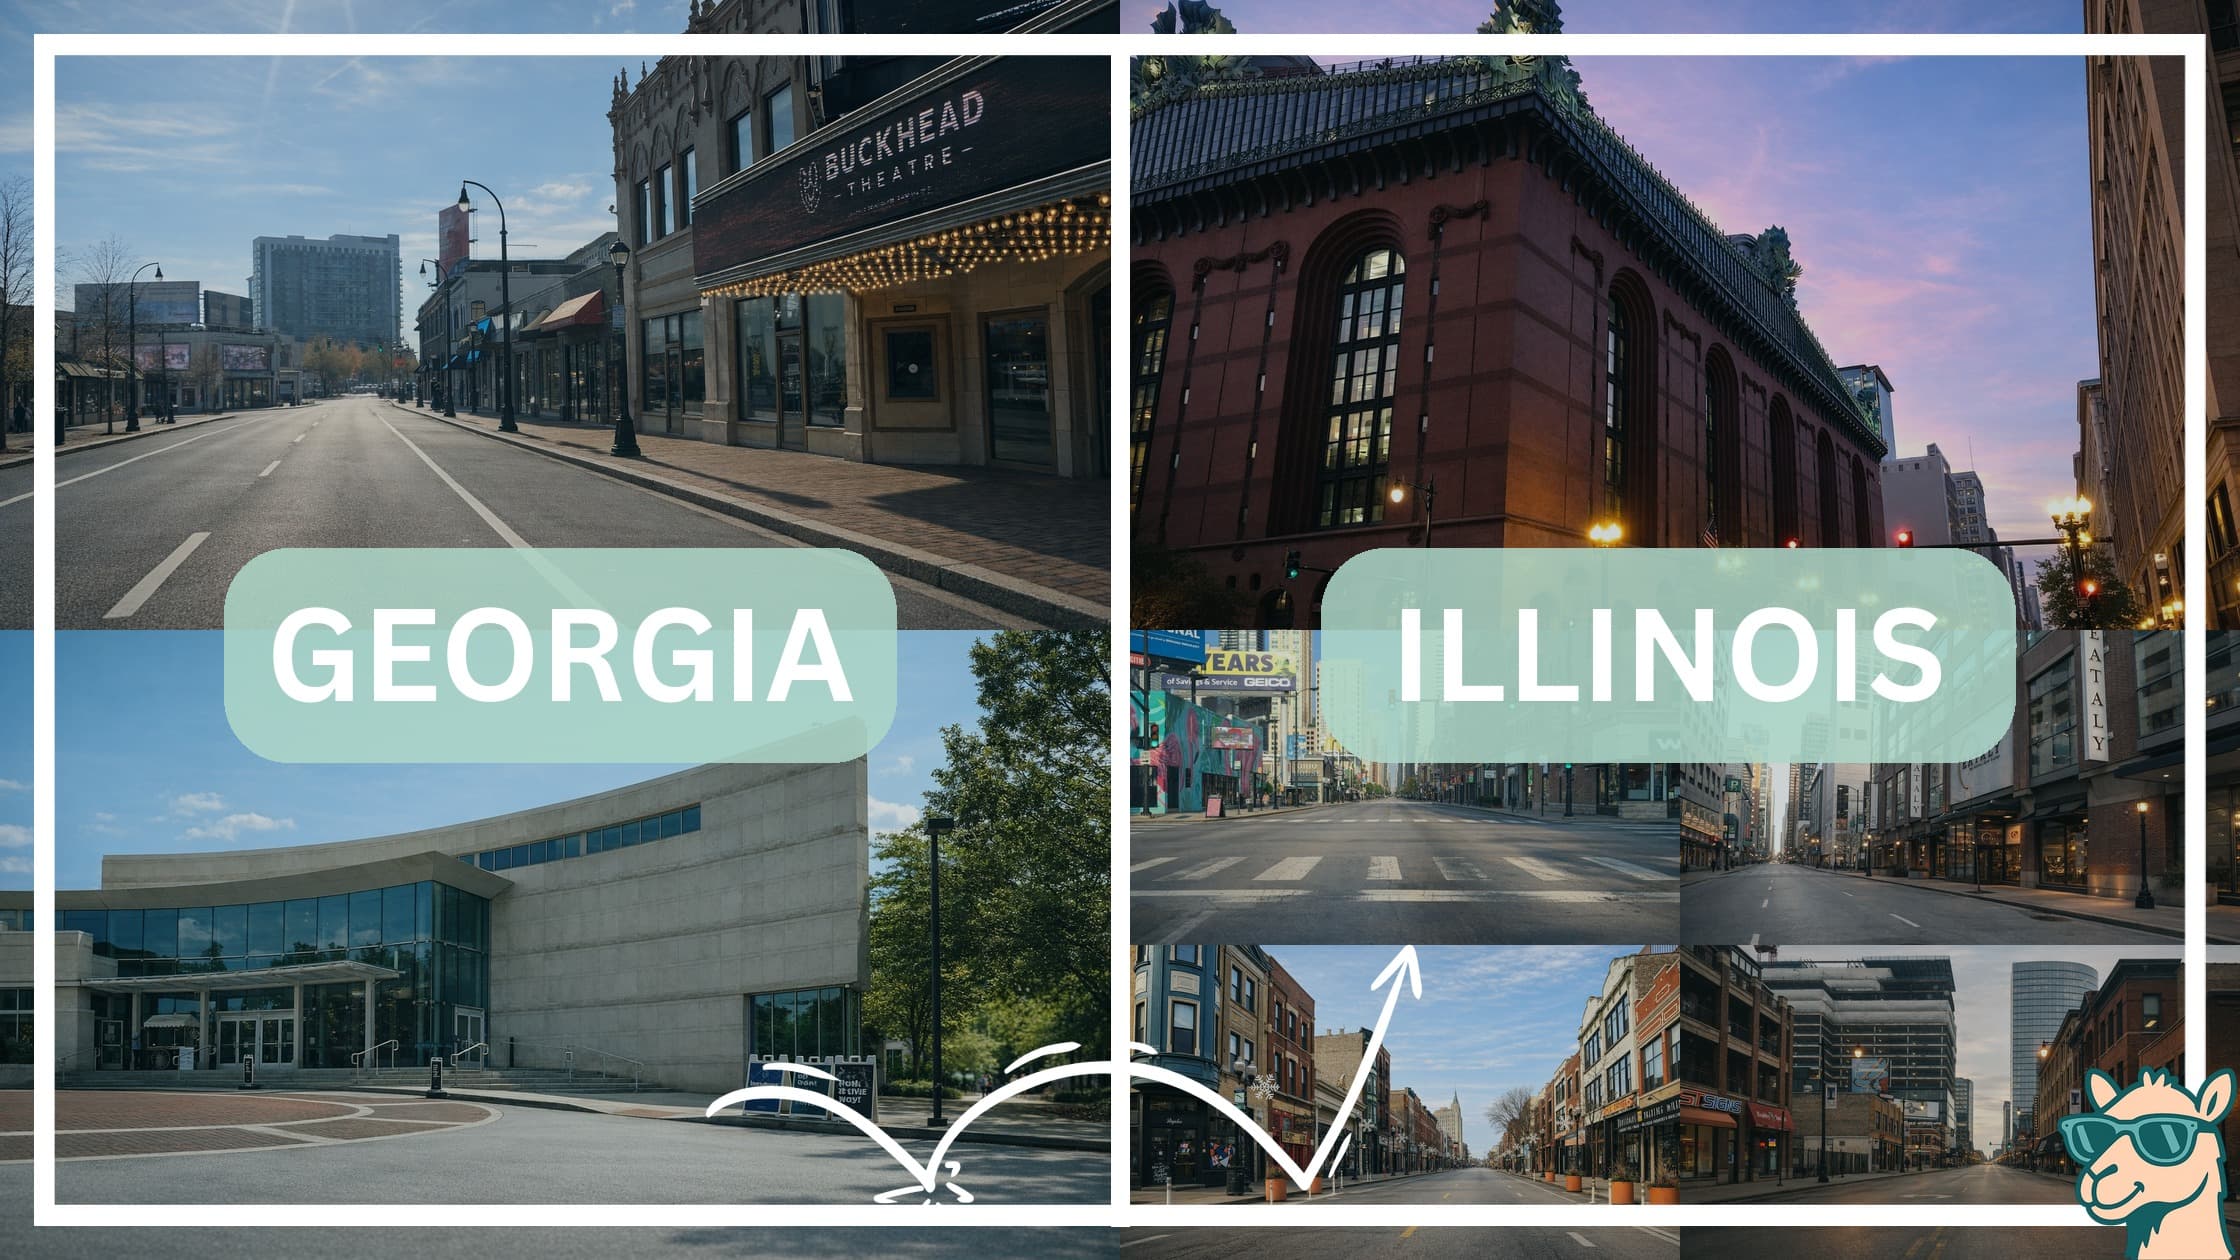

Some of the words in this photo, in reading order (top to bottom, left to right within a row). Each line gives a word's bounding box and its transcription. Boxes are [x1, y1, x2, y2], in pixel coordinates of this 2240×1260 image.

[825, 90, 984, 181] BUCKHEAD
[847, 146, 952, 196] THEATRE
[1166, 678, 1175, 686] of
[1176, 678, 1204, 687] Savigs
[1211, 678, 1238, 686] Service
[1244, 678, 1291, 687] GEICO
[2089, 630, 2105, 751] EATALY
[1912, 764, 1921, 813] ATALY
